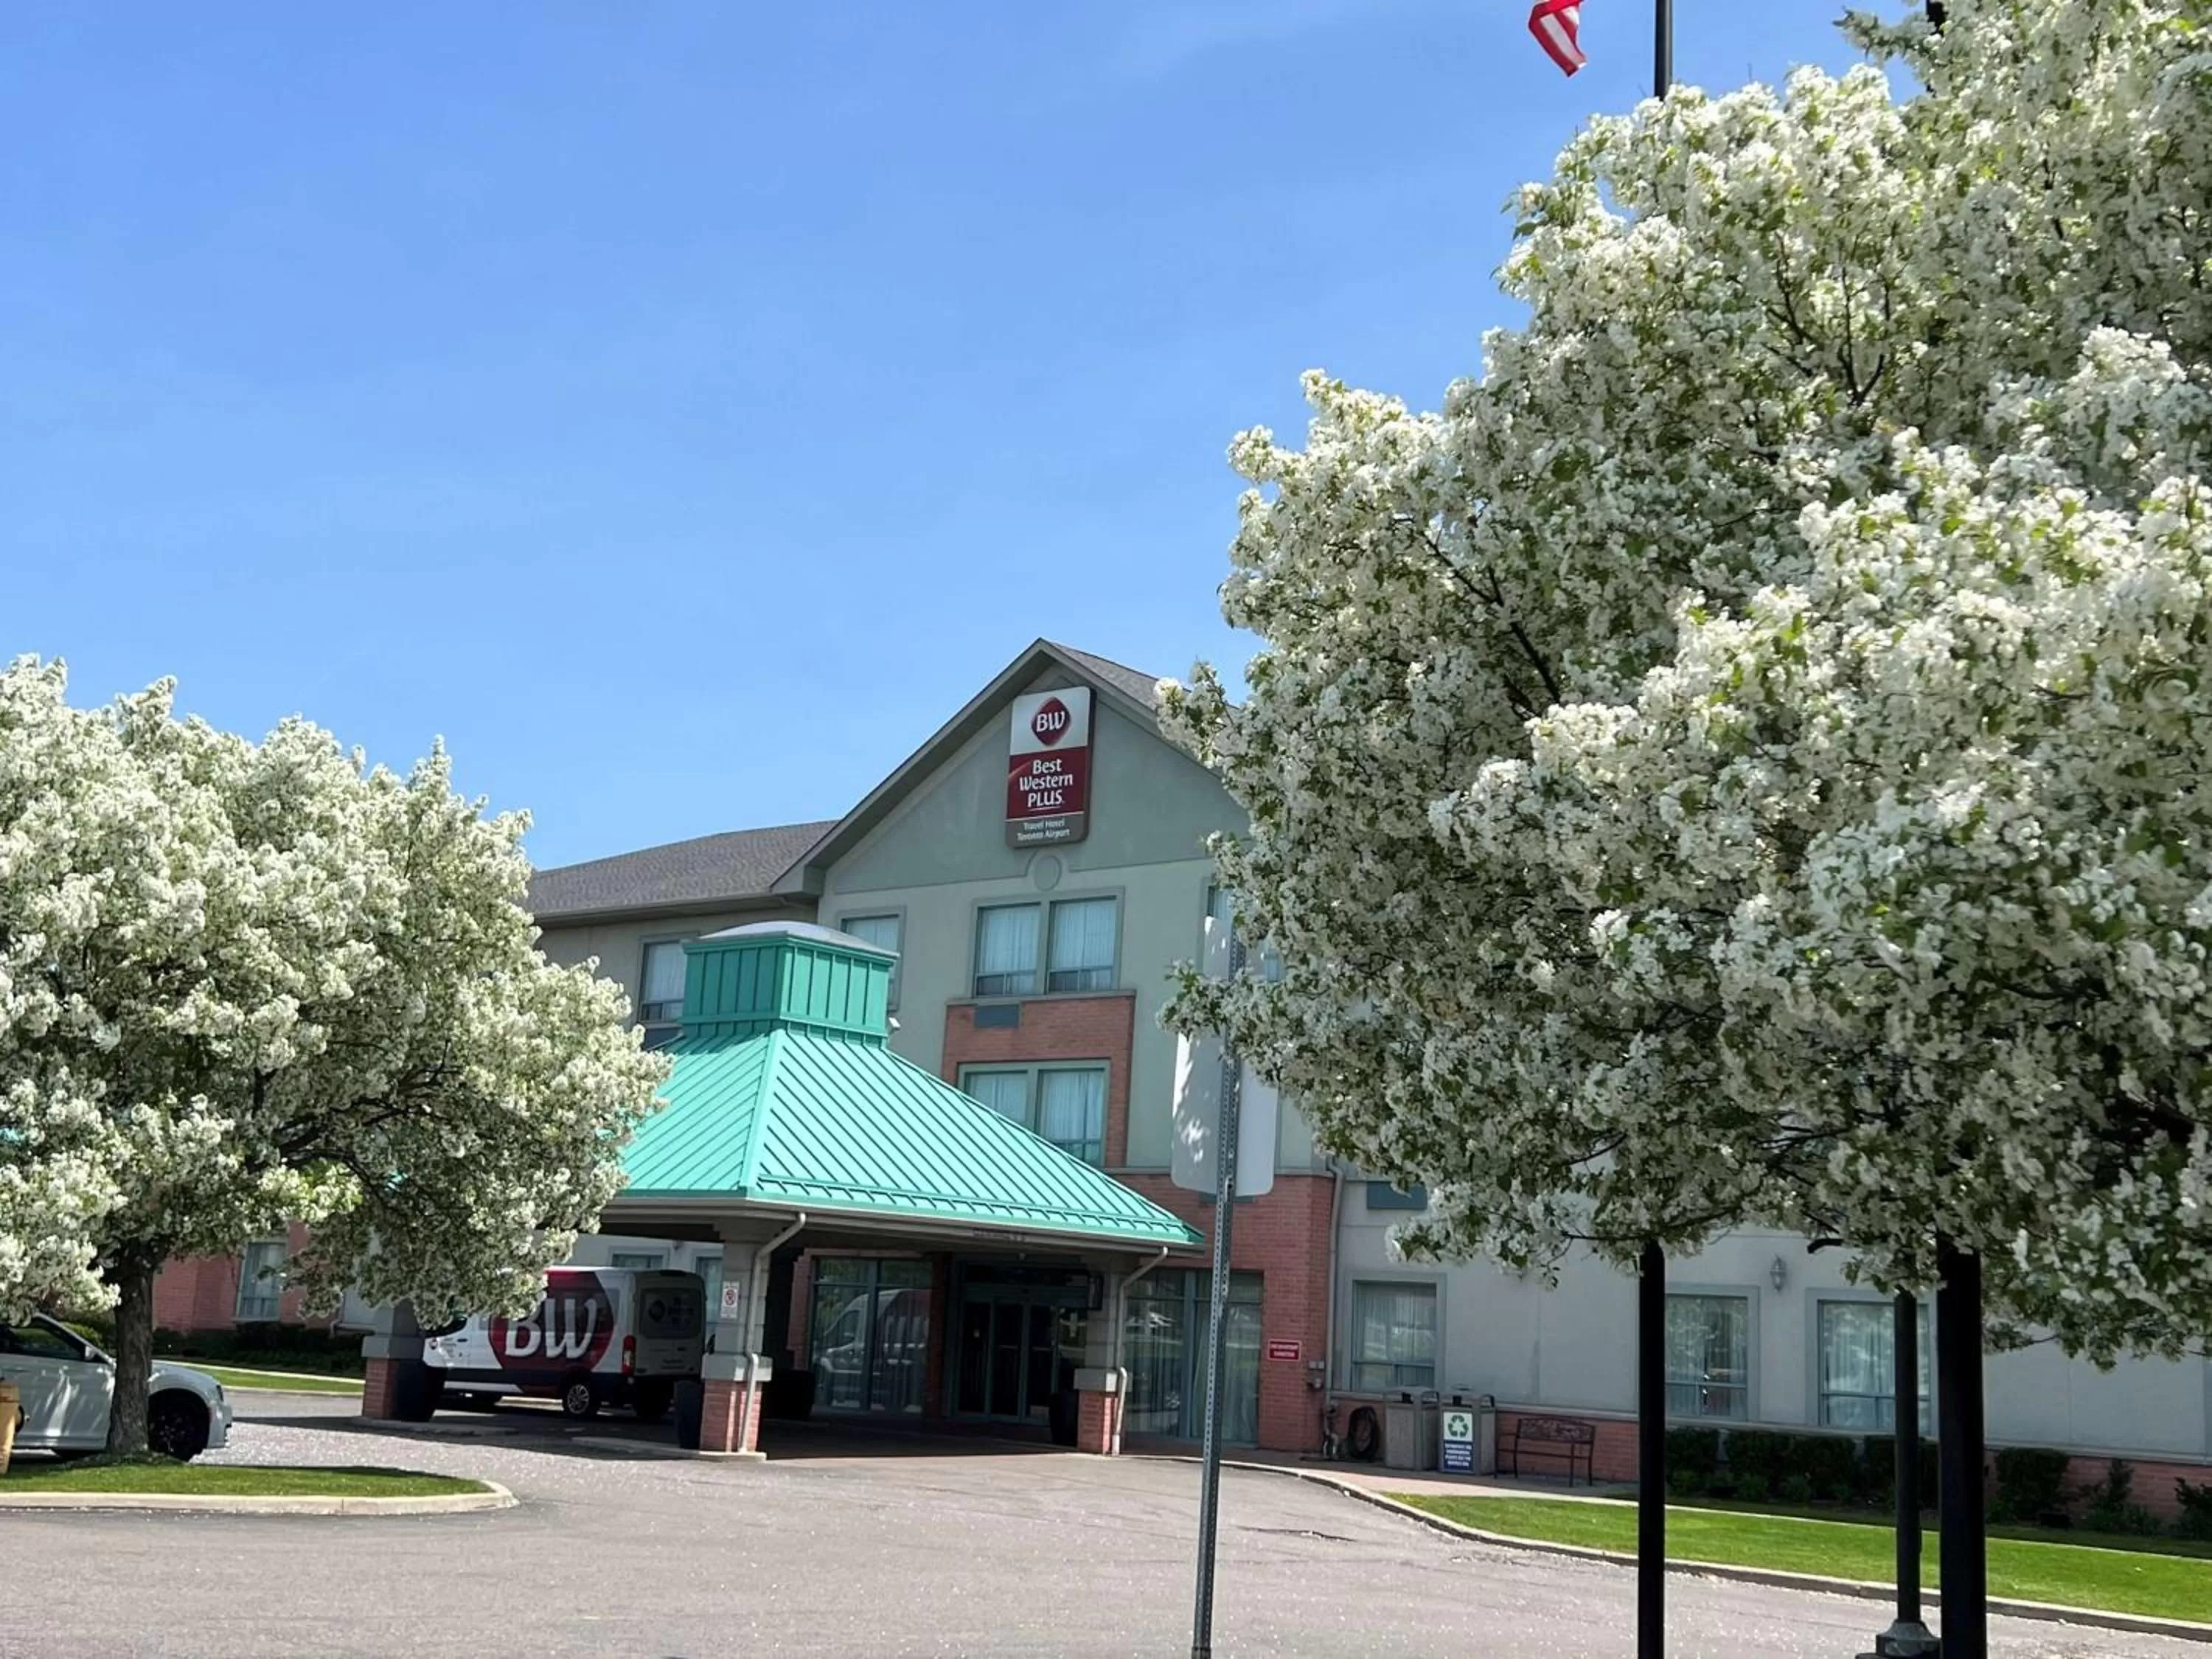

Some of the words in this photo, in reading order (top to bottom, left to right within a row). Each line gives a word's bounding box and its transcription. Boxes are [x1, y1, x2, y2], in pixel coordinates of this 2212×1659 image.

[1036, 710, 1065, 732] BW
[1032, 758, 1062, 774] Best
[1019, 773, 1074, 791] Western
[1027, 790, 1063, 808] PLUS
